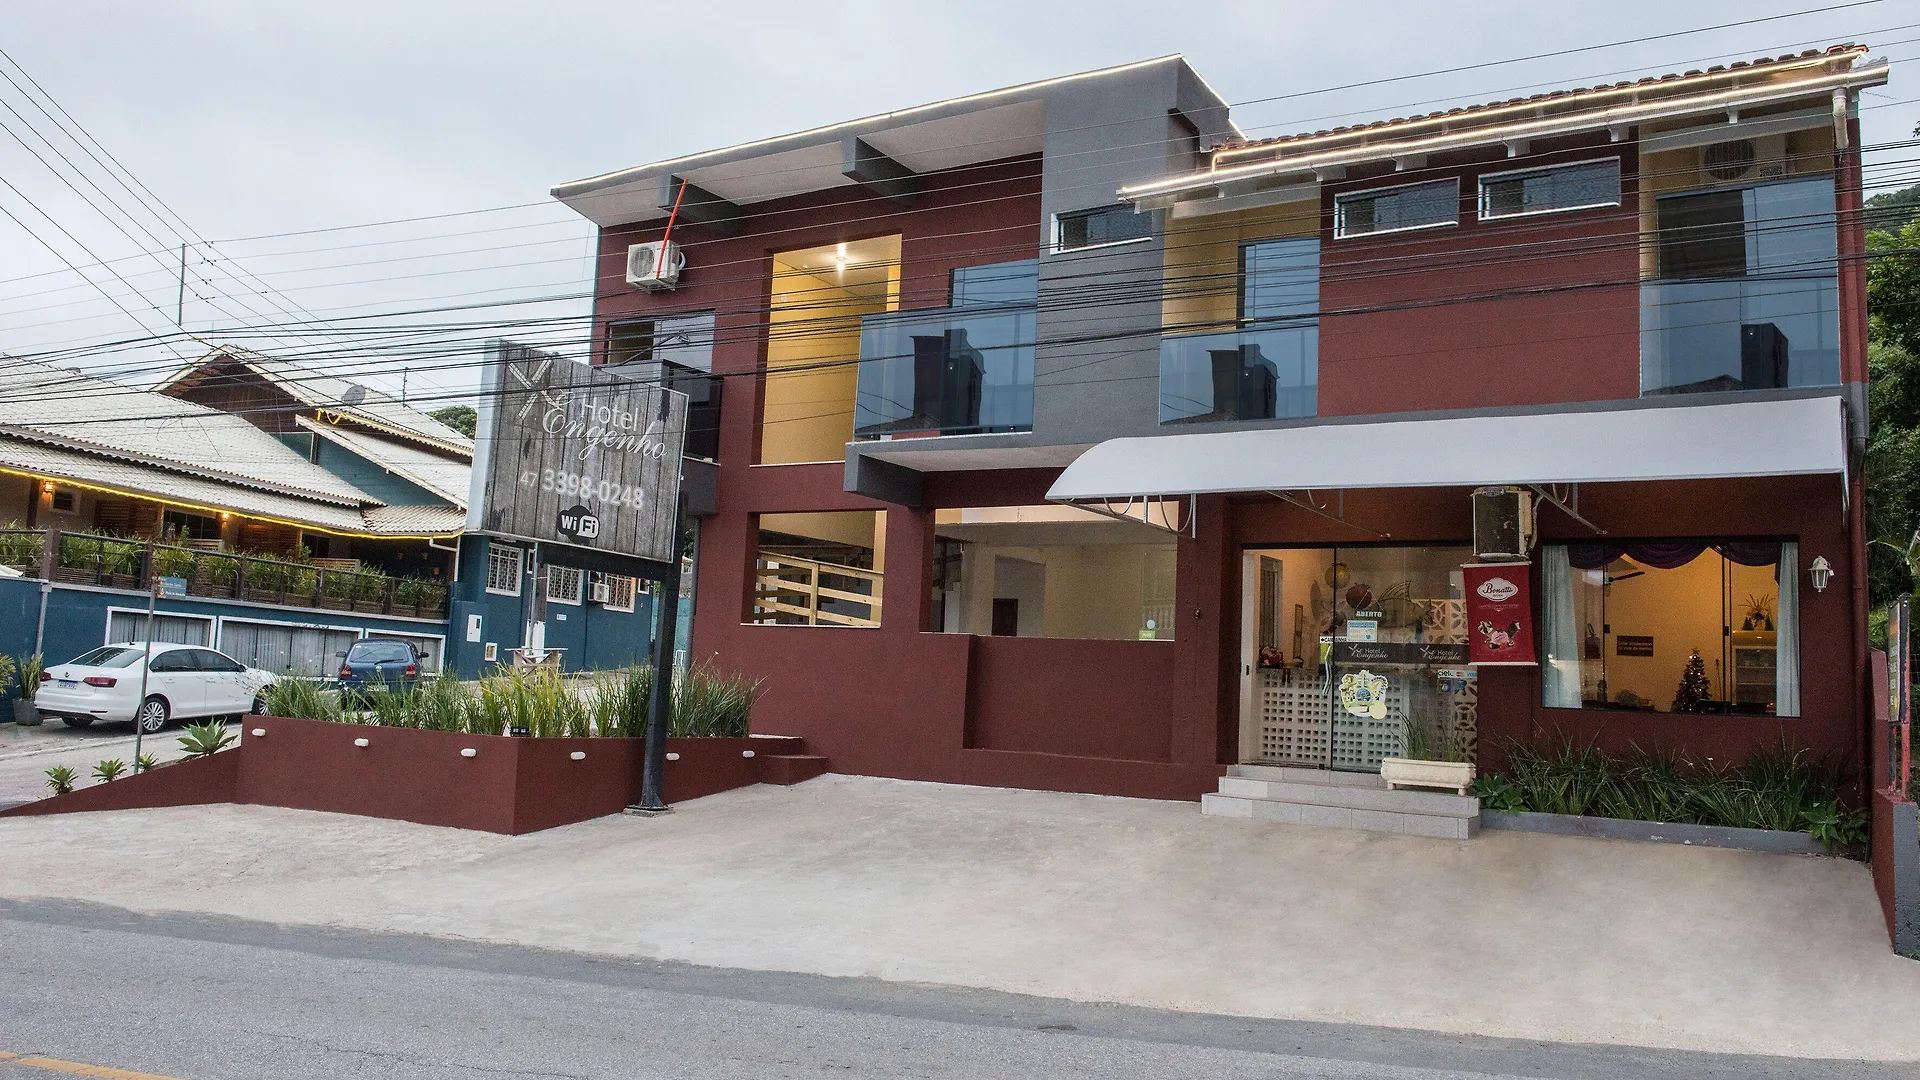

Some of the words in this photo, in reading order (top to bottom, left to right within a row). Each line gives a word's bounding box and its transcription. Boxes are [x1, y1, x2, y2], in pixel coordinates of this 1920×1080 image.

[581, 393, 639, 432] Hotel
[542, 407, 668, 461] Engenho
[520, 472, 537, 488] 47
[543, 469, 644, 509] 3398-0248
[1355, 610, 1383, 618] ABERTO
